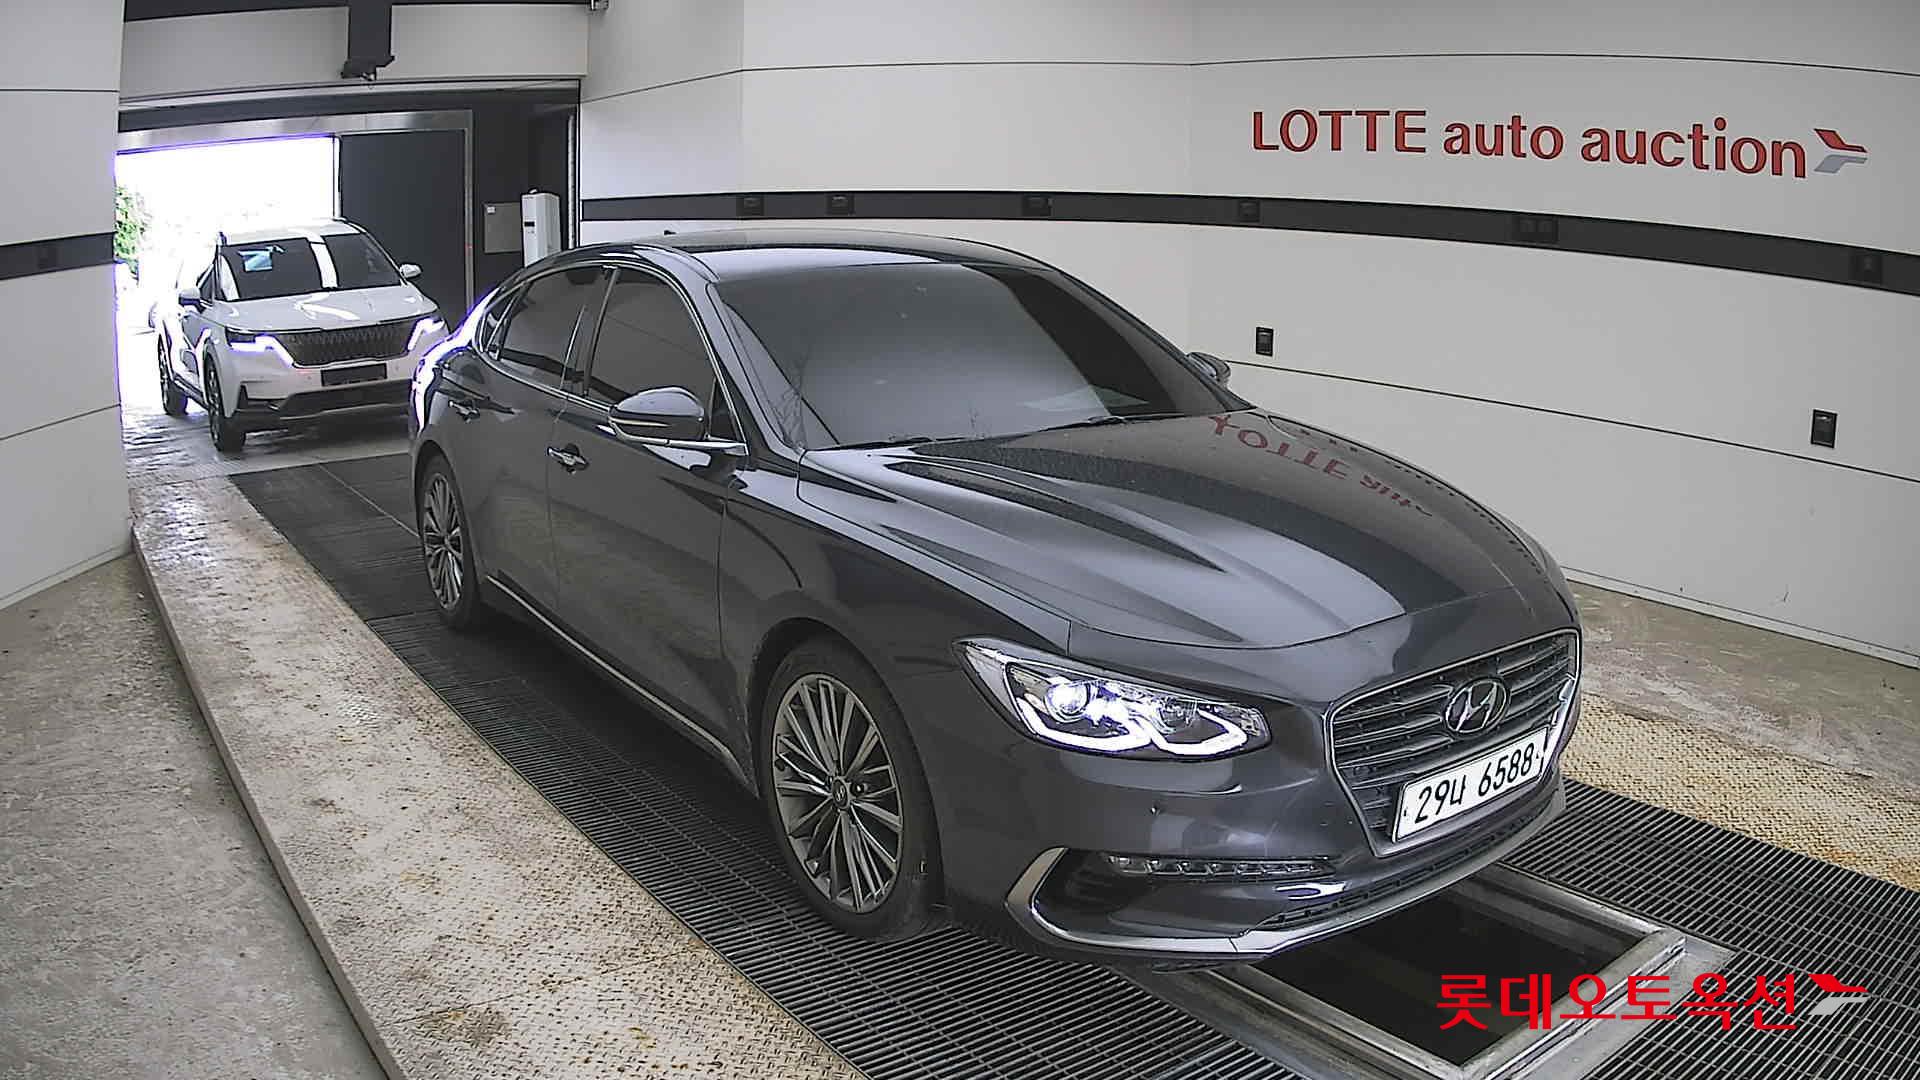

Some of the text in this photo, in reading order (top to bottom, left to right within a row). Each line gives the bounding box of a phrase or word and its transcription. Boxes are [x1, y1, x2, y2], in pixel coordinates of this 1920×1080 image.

[1252, 109, 1807, 179] LOTTE auto auction
[1478, 742, 1536, 798] 6588
